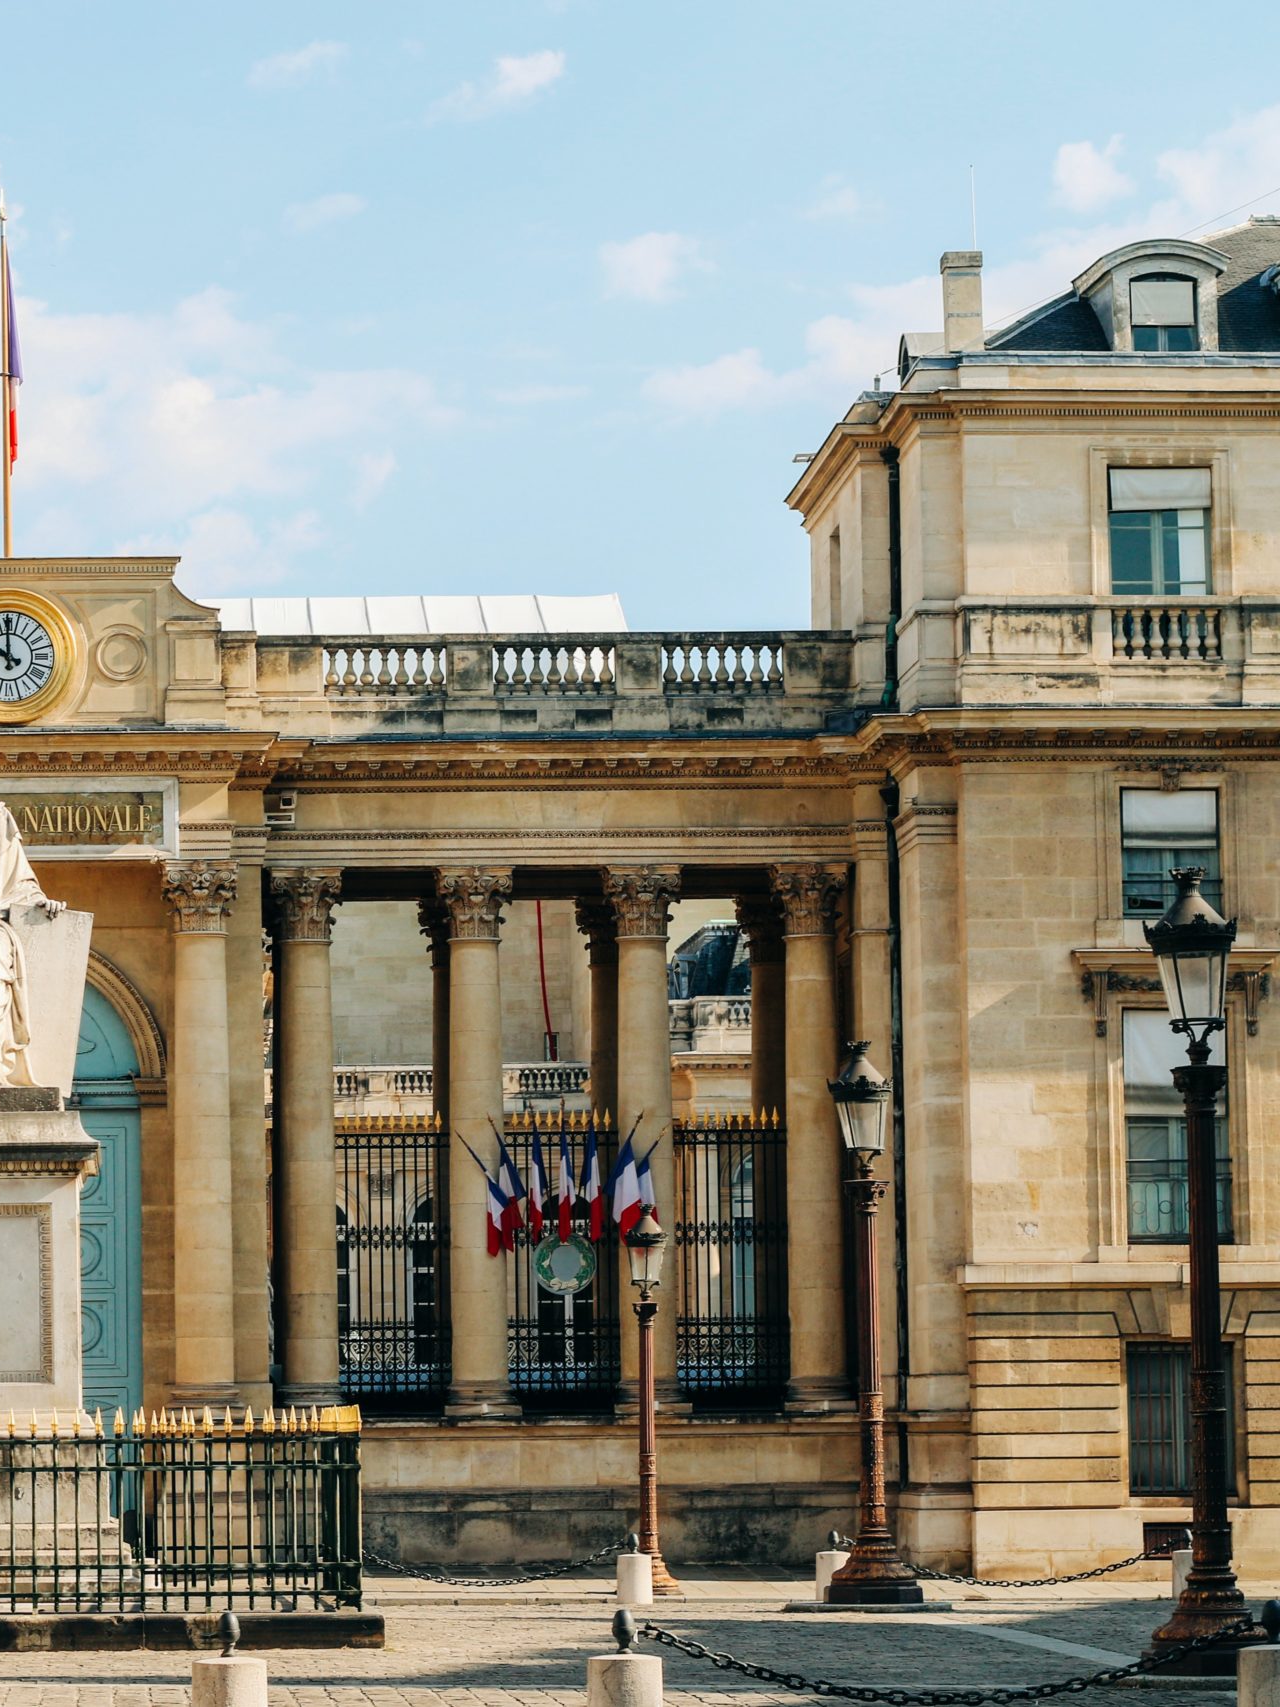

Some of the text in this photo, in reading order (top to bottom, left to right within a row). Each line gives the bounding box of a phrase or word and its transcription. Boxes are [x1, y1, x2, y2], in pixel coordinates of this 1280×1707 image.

[20, 622, 29, 635] I
[30, 635, 44, 646] II
[5, 683, 14, 697] VI
[21, 679, 31, 692] V
[24, 805, 153, 833] NATIONALE
